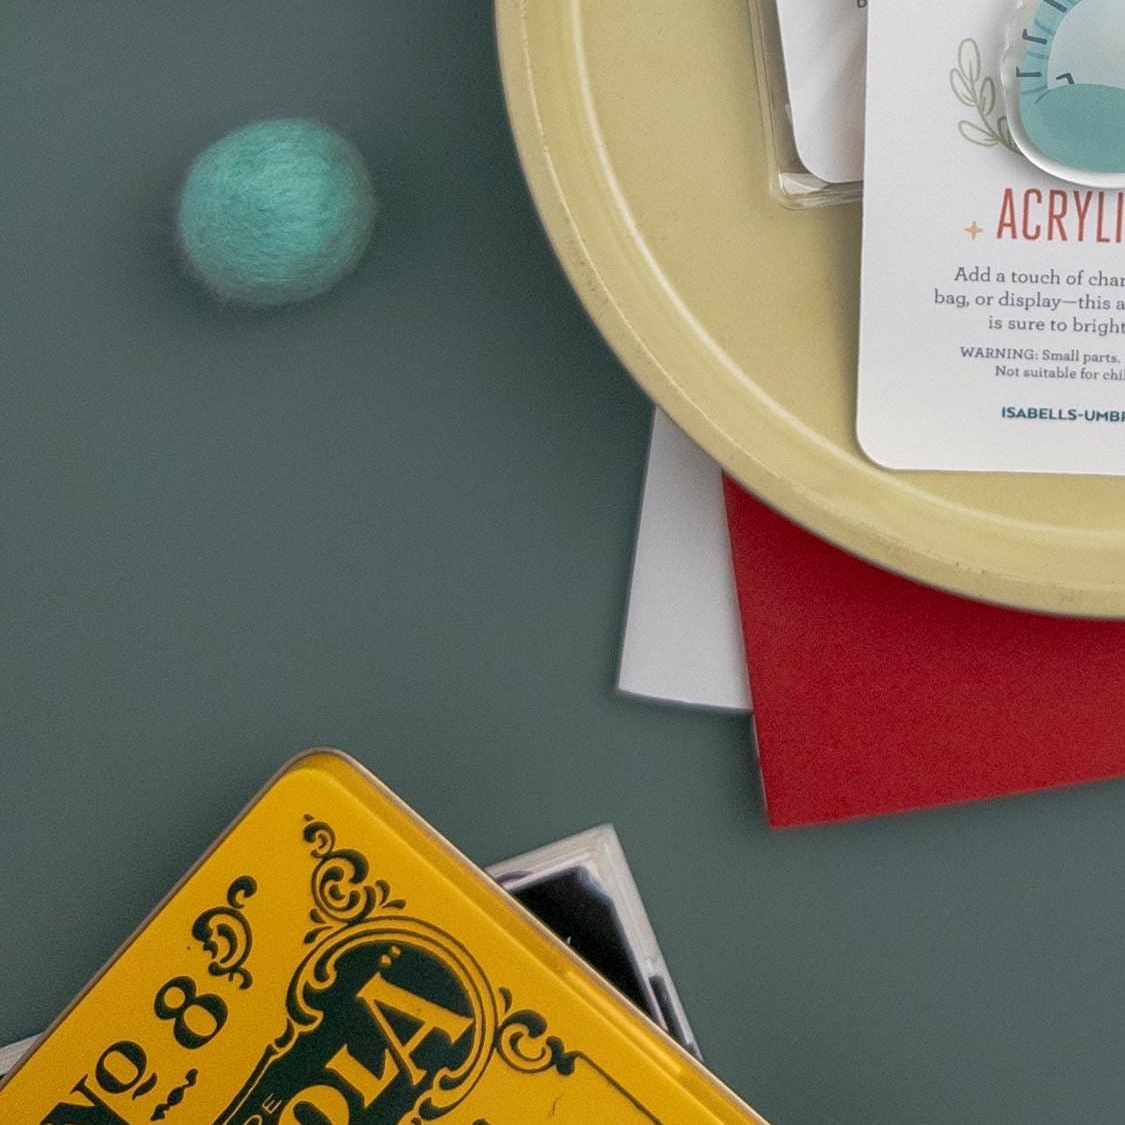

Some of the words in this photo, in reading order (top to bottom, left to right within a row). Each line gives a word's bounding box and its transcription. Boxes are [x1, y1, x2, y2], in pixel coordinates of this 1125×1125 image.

[954, 266, 991, 283] Add
[995, 271, 1006, 283] a
[1011, 269, 1060, 285] touch
[1066, 270, 1085, 286] of
[934, 288, 970, 308] bag,
[975, 295, 994, 306] or
[988, 315, 1003, 330] is
[1007, 318, 1046, 331] sure
[1050, 319, 1068, 332] to
[960, 346, 1039, 360] WARNING:
[1042, 349, 1080, 362] Small
[1083, 352, 1121, 365] parts.
[995, 365, 1020, 377] Not
[1023, 366, 1077, 379] suitable
[1080, 367, 1100, 380] for
[153, 975, 229, 1050] 8
